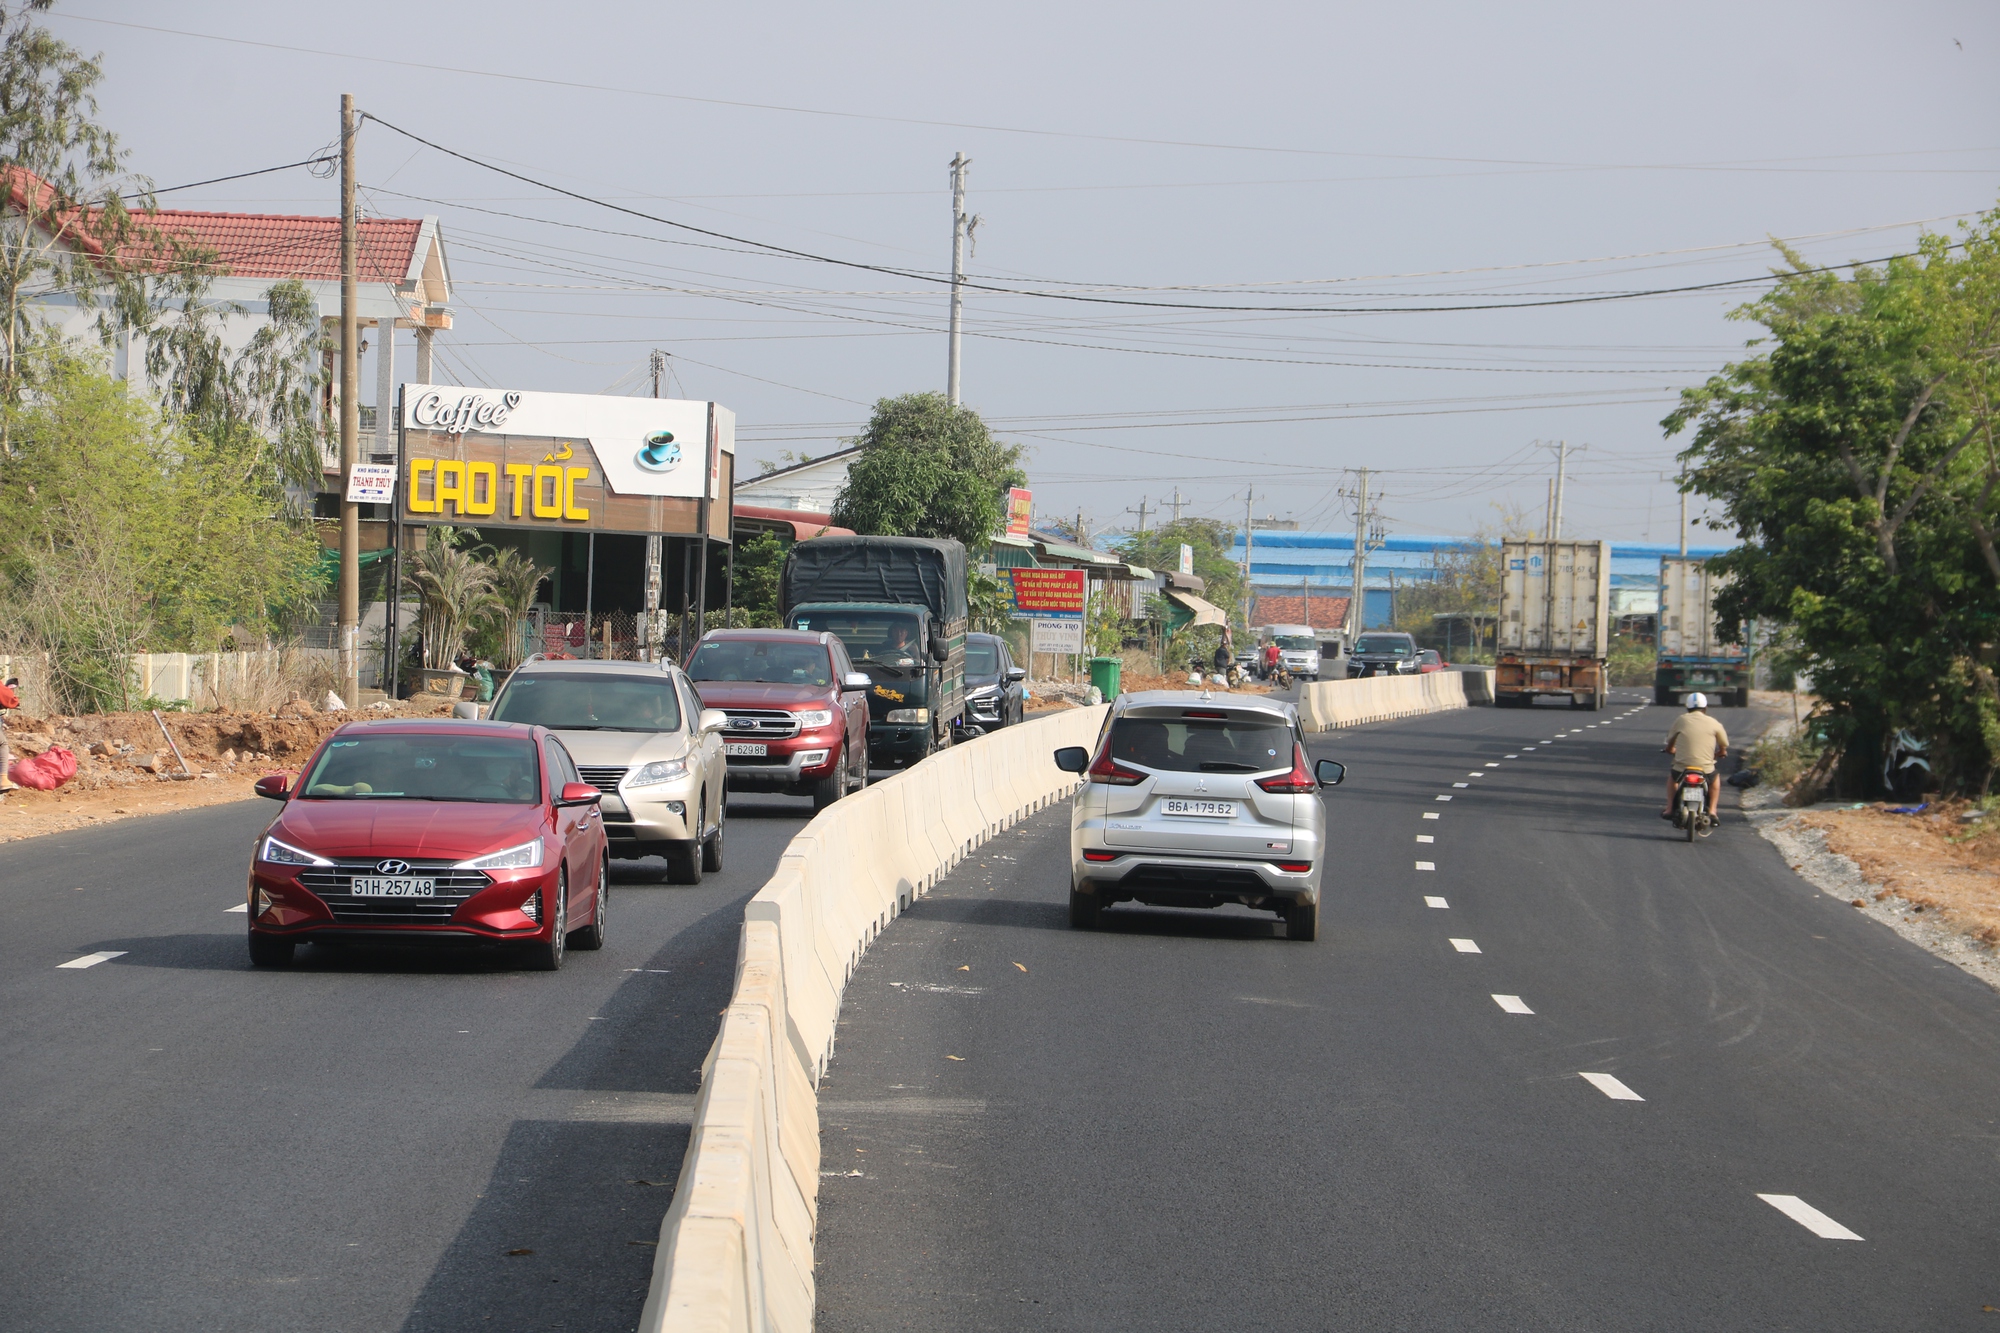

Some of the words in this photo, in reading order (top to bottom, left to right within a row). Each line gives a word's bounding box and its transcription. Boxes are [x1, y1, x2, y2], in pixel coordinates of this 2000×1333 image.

[415, 391, 507, 433] Coffee
[353, 476, 373, 487] THANH
[409, 459, 496, 515] CAO
[505, 441, 589, 520] TỐC
[1038, 621, 1062, 629] PHÒNG
[1064, 623, 1078, 631] TRỌ
[724, 744, 765, 755] 1F-629.86
[1168, 801, 1231, 814] 86A-179.62
[354, 879, 432, 896] 51H-257.48
